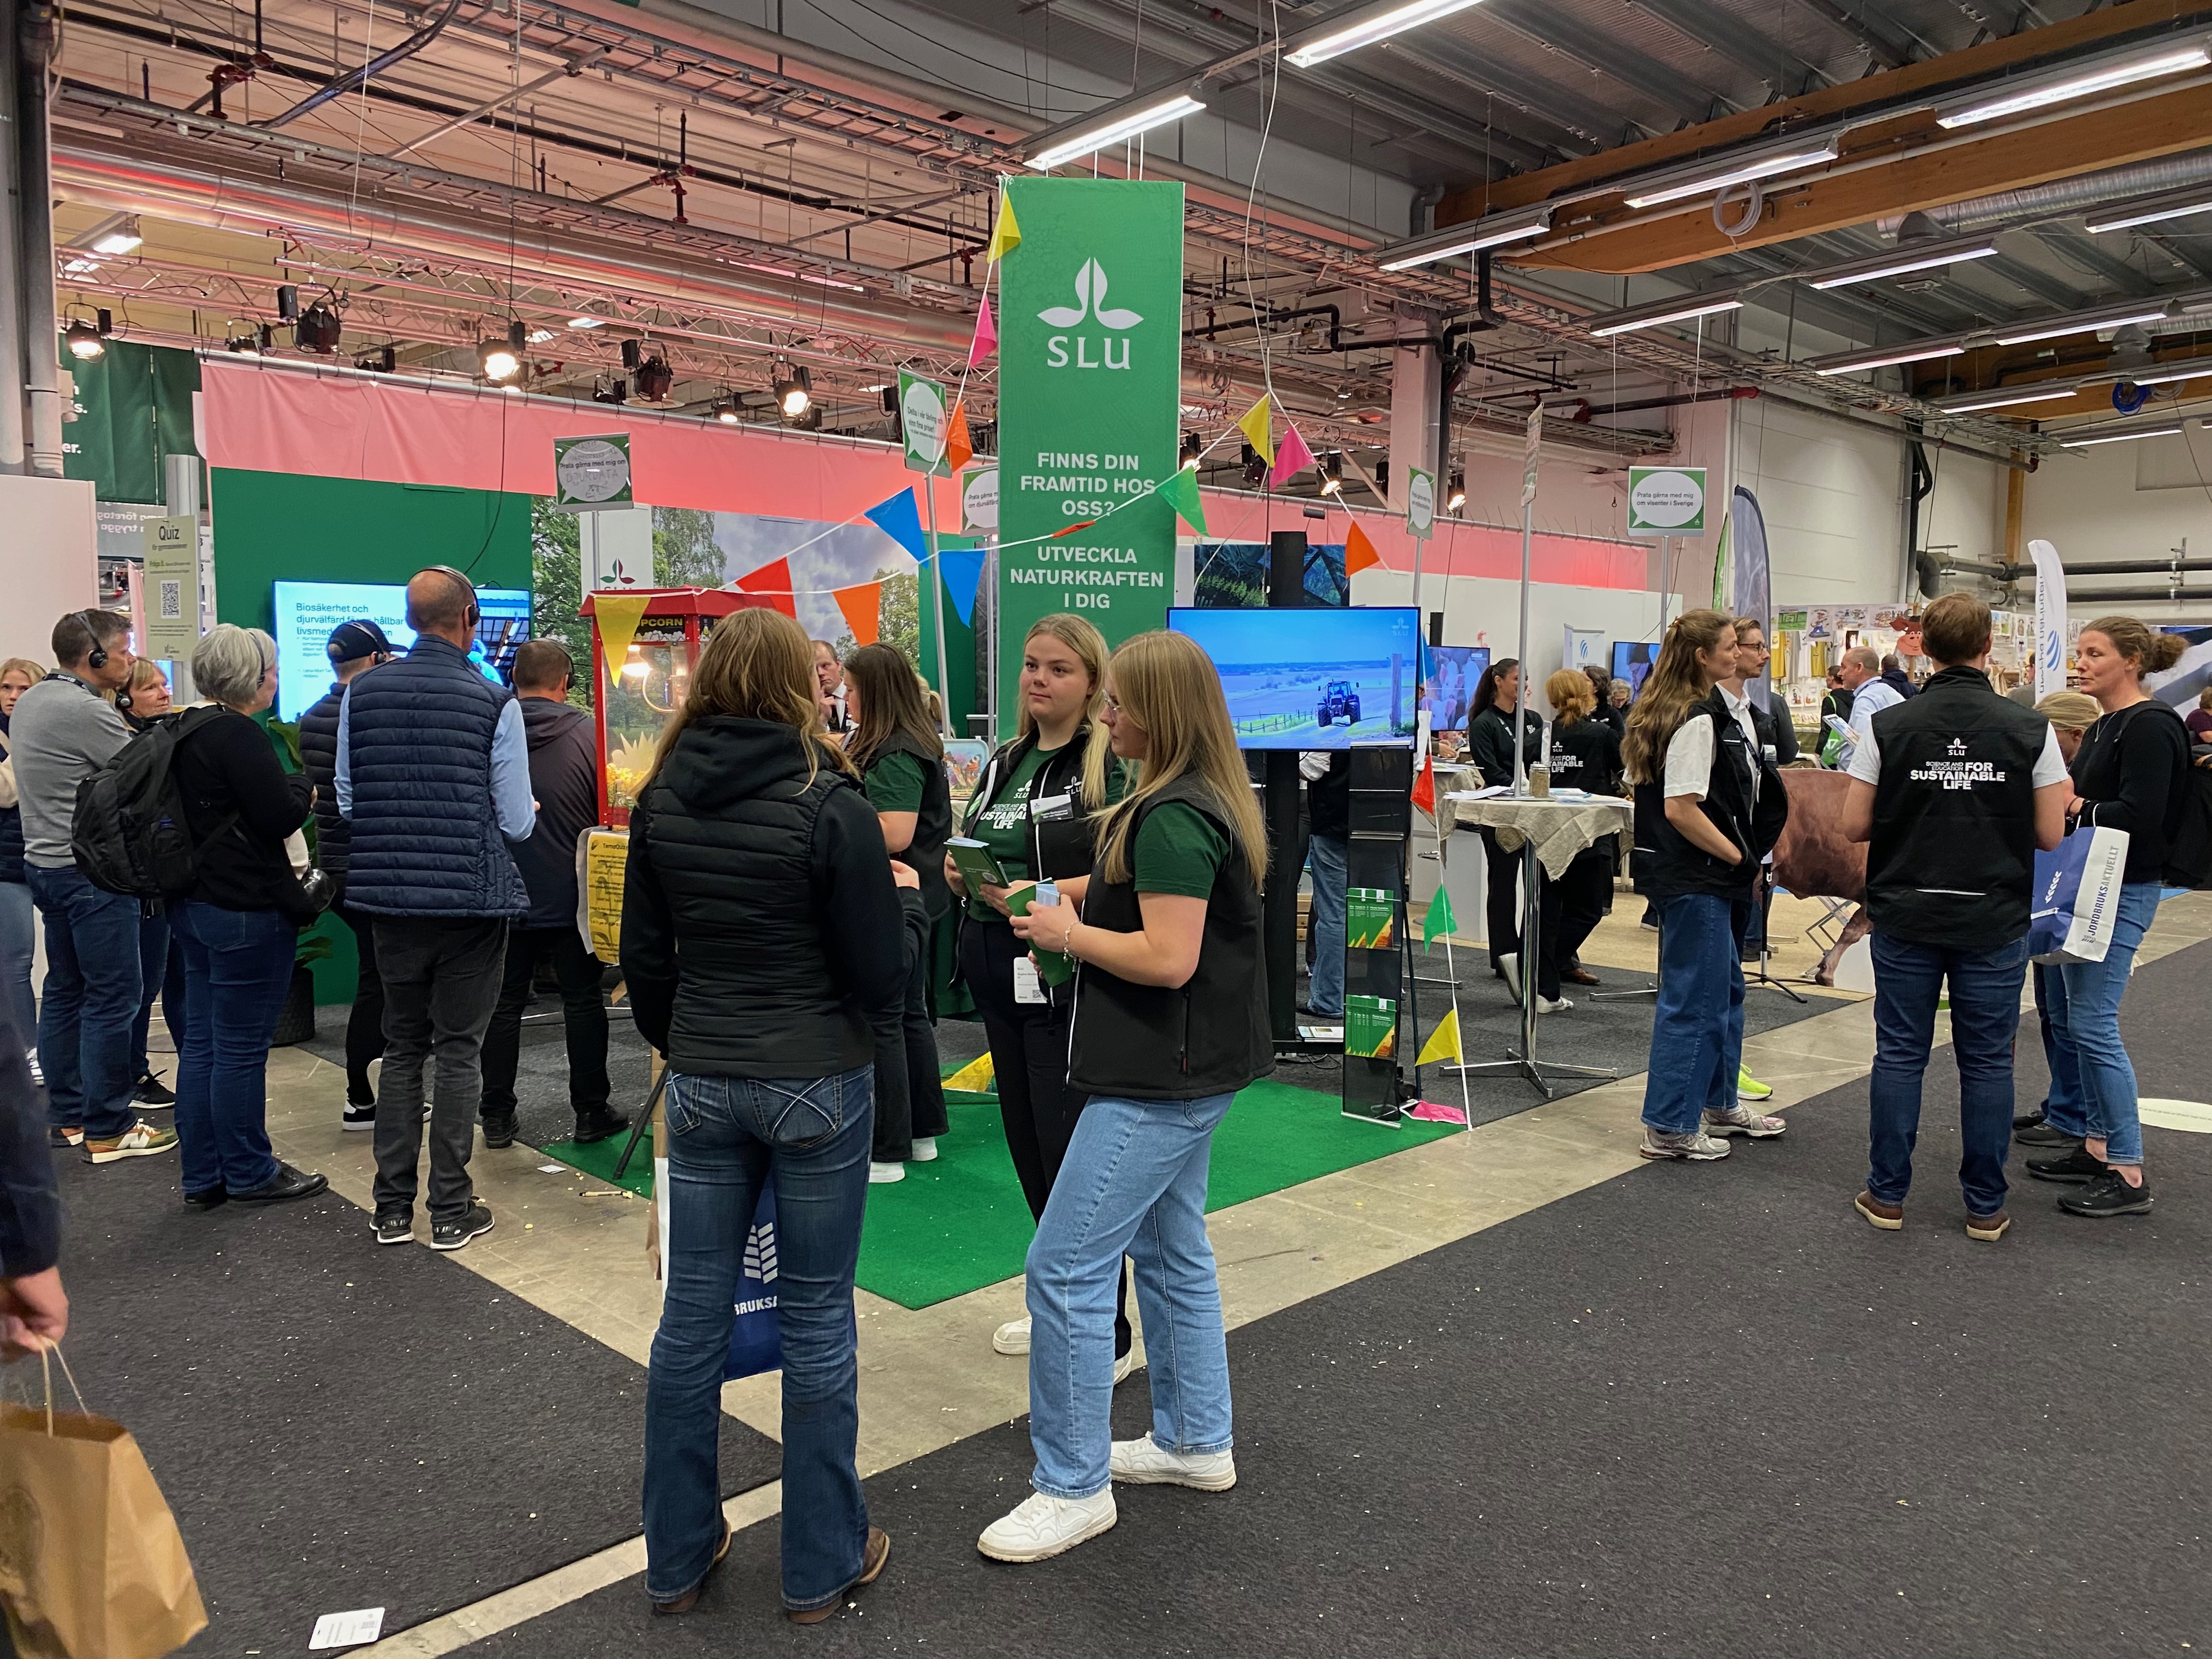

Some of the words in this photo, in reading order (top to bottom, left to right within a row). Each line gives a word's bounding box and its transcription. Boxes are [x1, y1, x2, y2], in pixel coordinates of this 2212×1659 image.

[1047, 336, 1131, 370] SLU
[907, 406, 917, 416] Delta
[1038, 453, 1098, 470] FINNS
[1104, 454, 1139, 470] DIN
[1020, 476, 1108, 493] FRAMTID
[1114, 478, 1156, 494] HOS
[1062, 500, 1115, 517] OSS?
[159, 525, 179, 540] Quiz
[1037, 546, 1137, 564] UTVECKLA
[1011, 569, 1164, 587] NATURKRAFTEN
[296, 603, 350, 613] Biosäkerhet
[352, 605, 369, 613] och
[1064, 593, 1069, 608] I
[1076, 594, 1110, 609] DIG
[296, 614, 345, 624] djurvälfärd
[374, 616, 404, 625] hållbar
[639, 618, 682, 627] PCORN
[1965, 761, 1993, 772] FOR
[1910, 769, 2006, 782] SUSTAINABLE
[1065, 786, 1081, 795] SLU
[1943, 780, 1972, 790] LIFE
[992, 819, 1015, 830] LIFE
[2087, 845, 2119, 936] JORDBRUKSAKTUELLT
